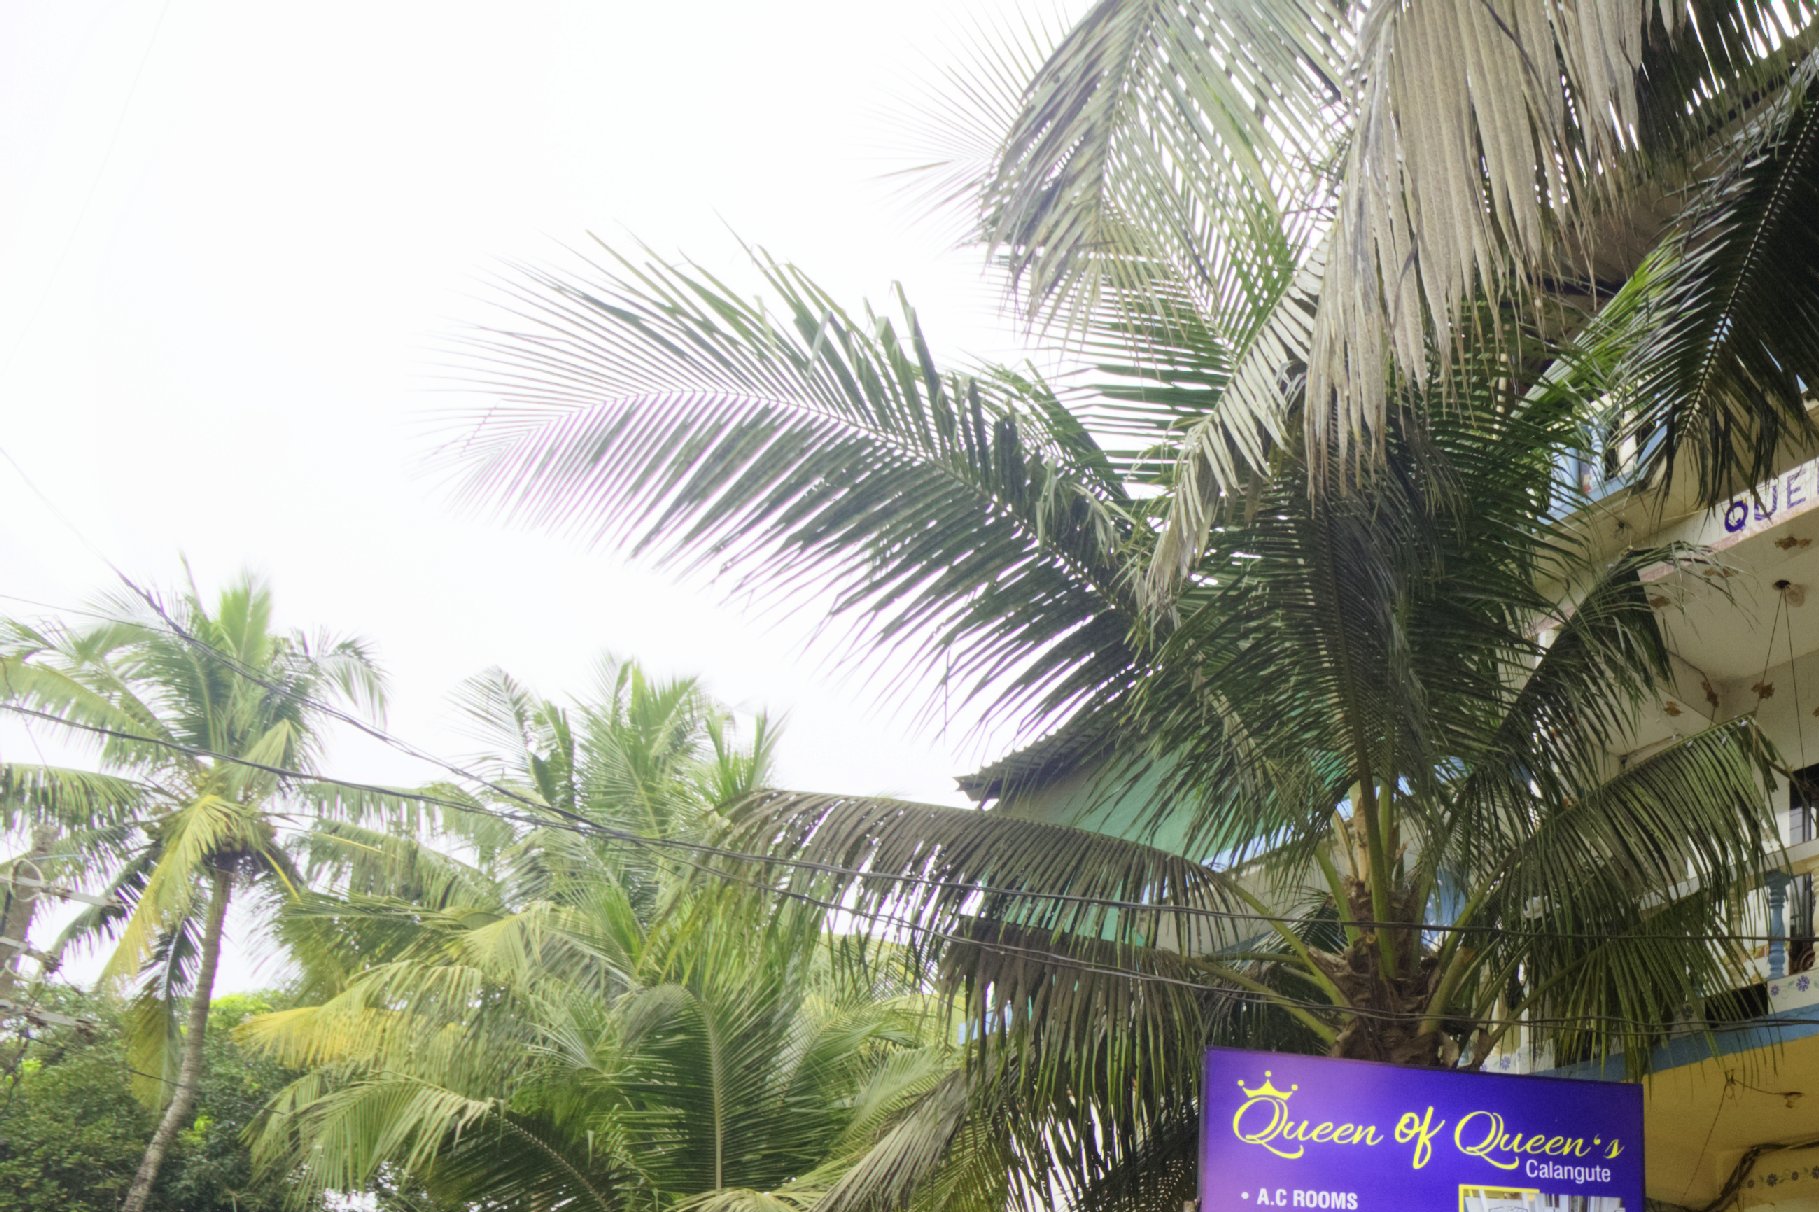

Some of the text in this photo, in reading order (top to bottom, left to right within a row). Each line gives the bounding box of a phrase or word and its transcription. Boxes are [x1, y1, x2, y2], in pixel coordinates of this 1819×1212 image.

[1233, 1097, 1624, 1170] Queen of Queen's
[1526, 1159, 1611, 1184] Calangute
[1257, 1188, 1358, 1210] A.C ROOMS
